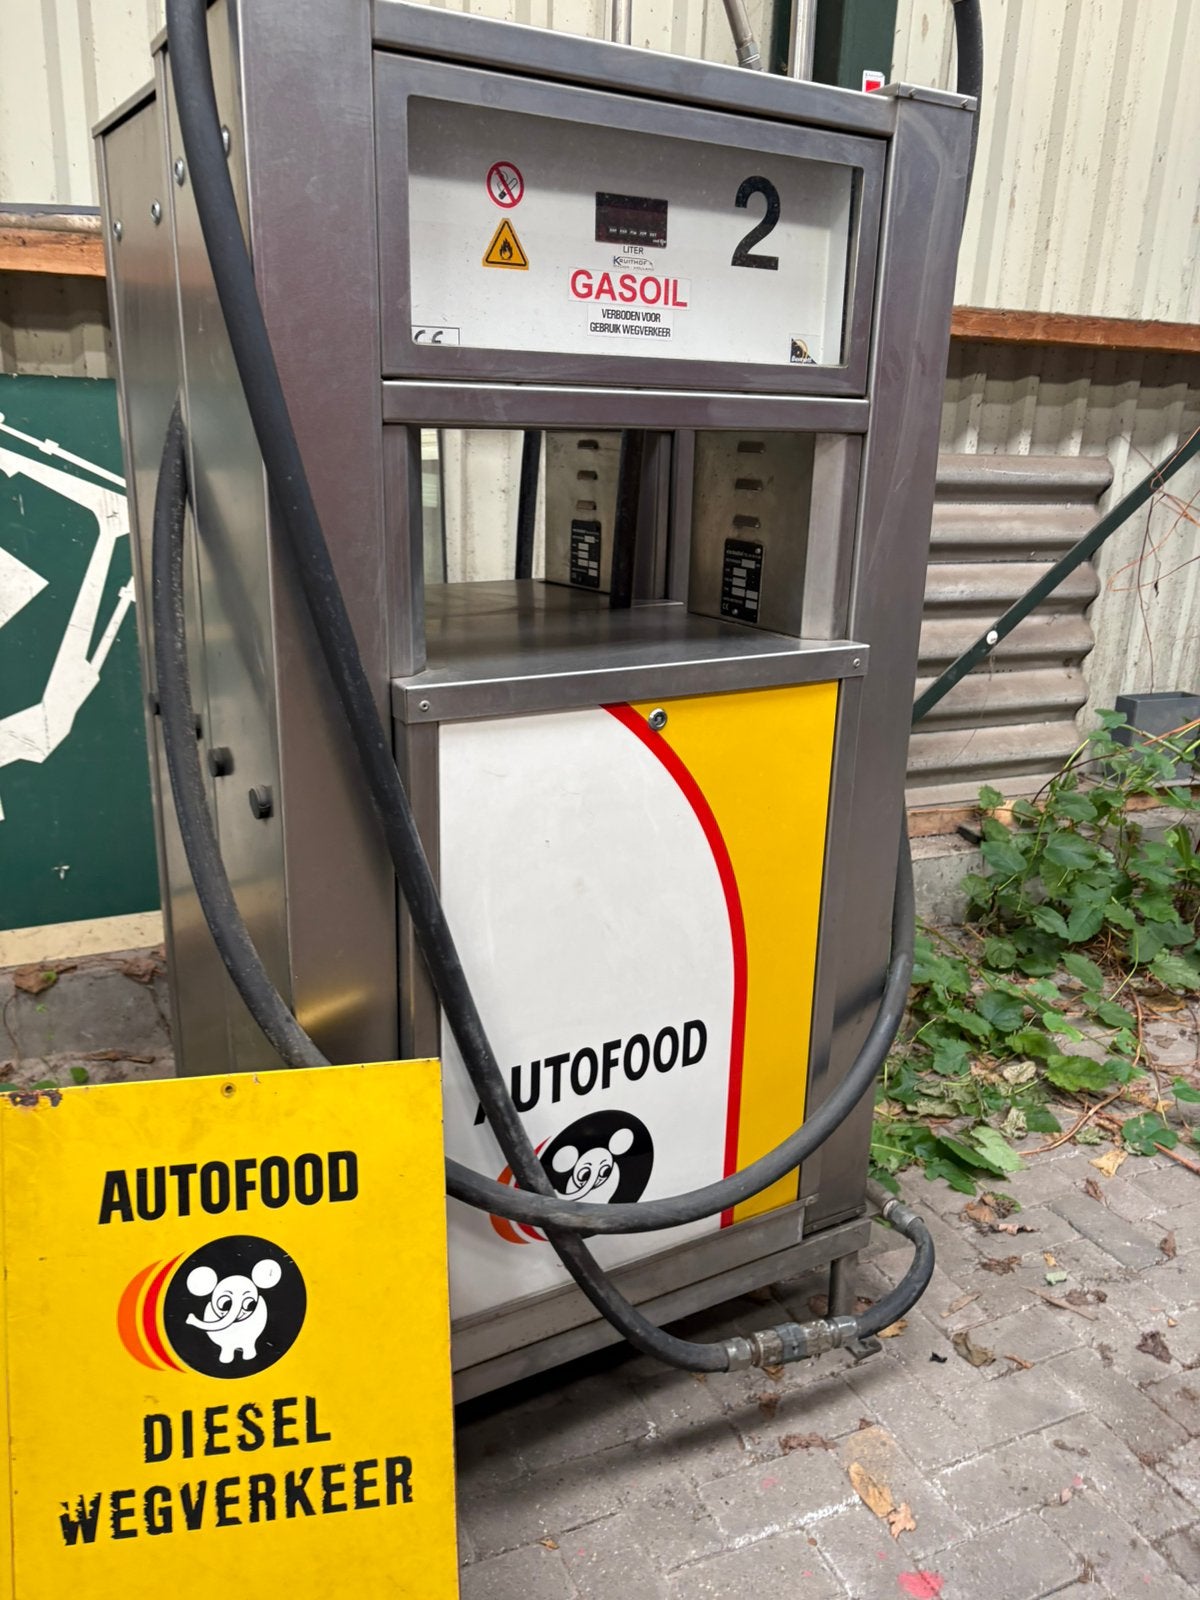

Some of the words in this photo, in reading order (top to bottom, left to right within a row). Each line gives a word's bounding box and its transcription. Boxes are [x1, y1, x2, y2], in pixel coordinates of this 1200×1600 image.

[623, 245, 644, 254] LITER
[731, 175, 780, 271] 2
[570, 269, 688, 307] GASOIL
[602, 308, 641, 322] VERBODEN
[641, 312, 661, 323] VOOR
[589, 321, 621, 335] GEBRUIK
[622, 324, 671, 338] WEGVERKEER
[473, 1019, 708, 1126] UTOFOOD
[98, 1150, 359, 1225] AUTOFOOD
[144, 1395, 331, 1463] DIESEL
[59, 1455, 413, 1546] WEGVERKEER
